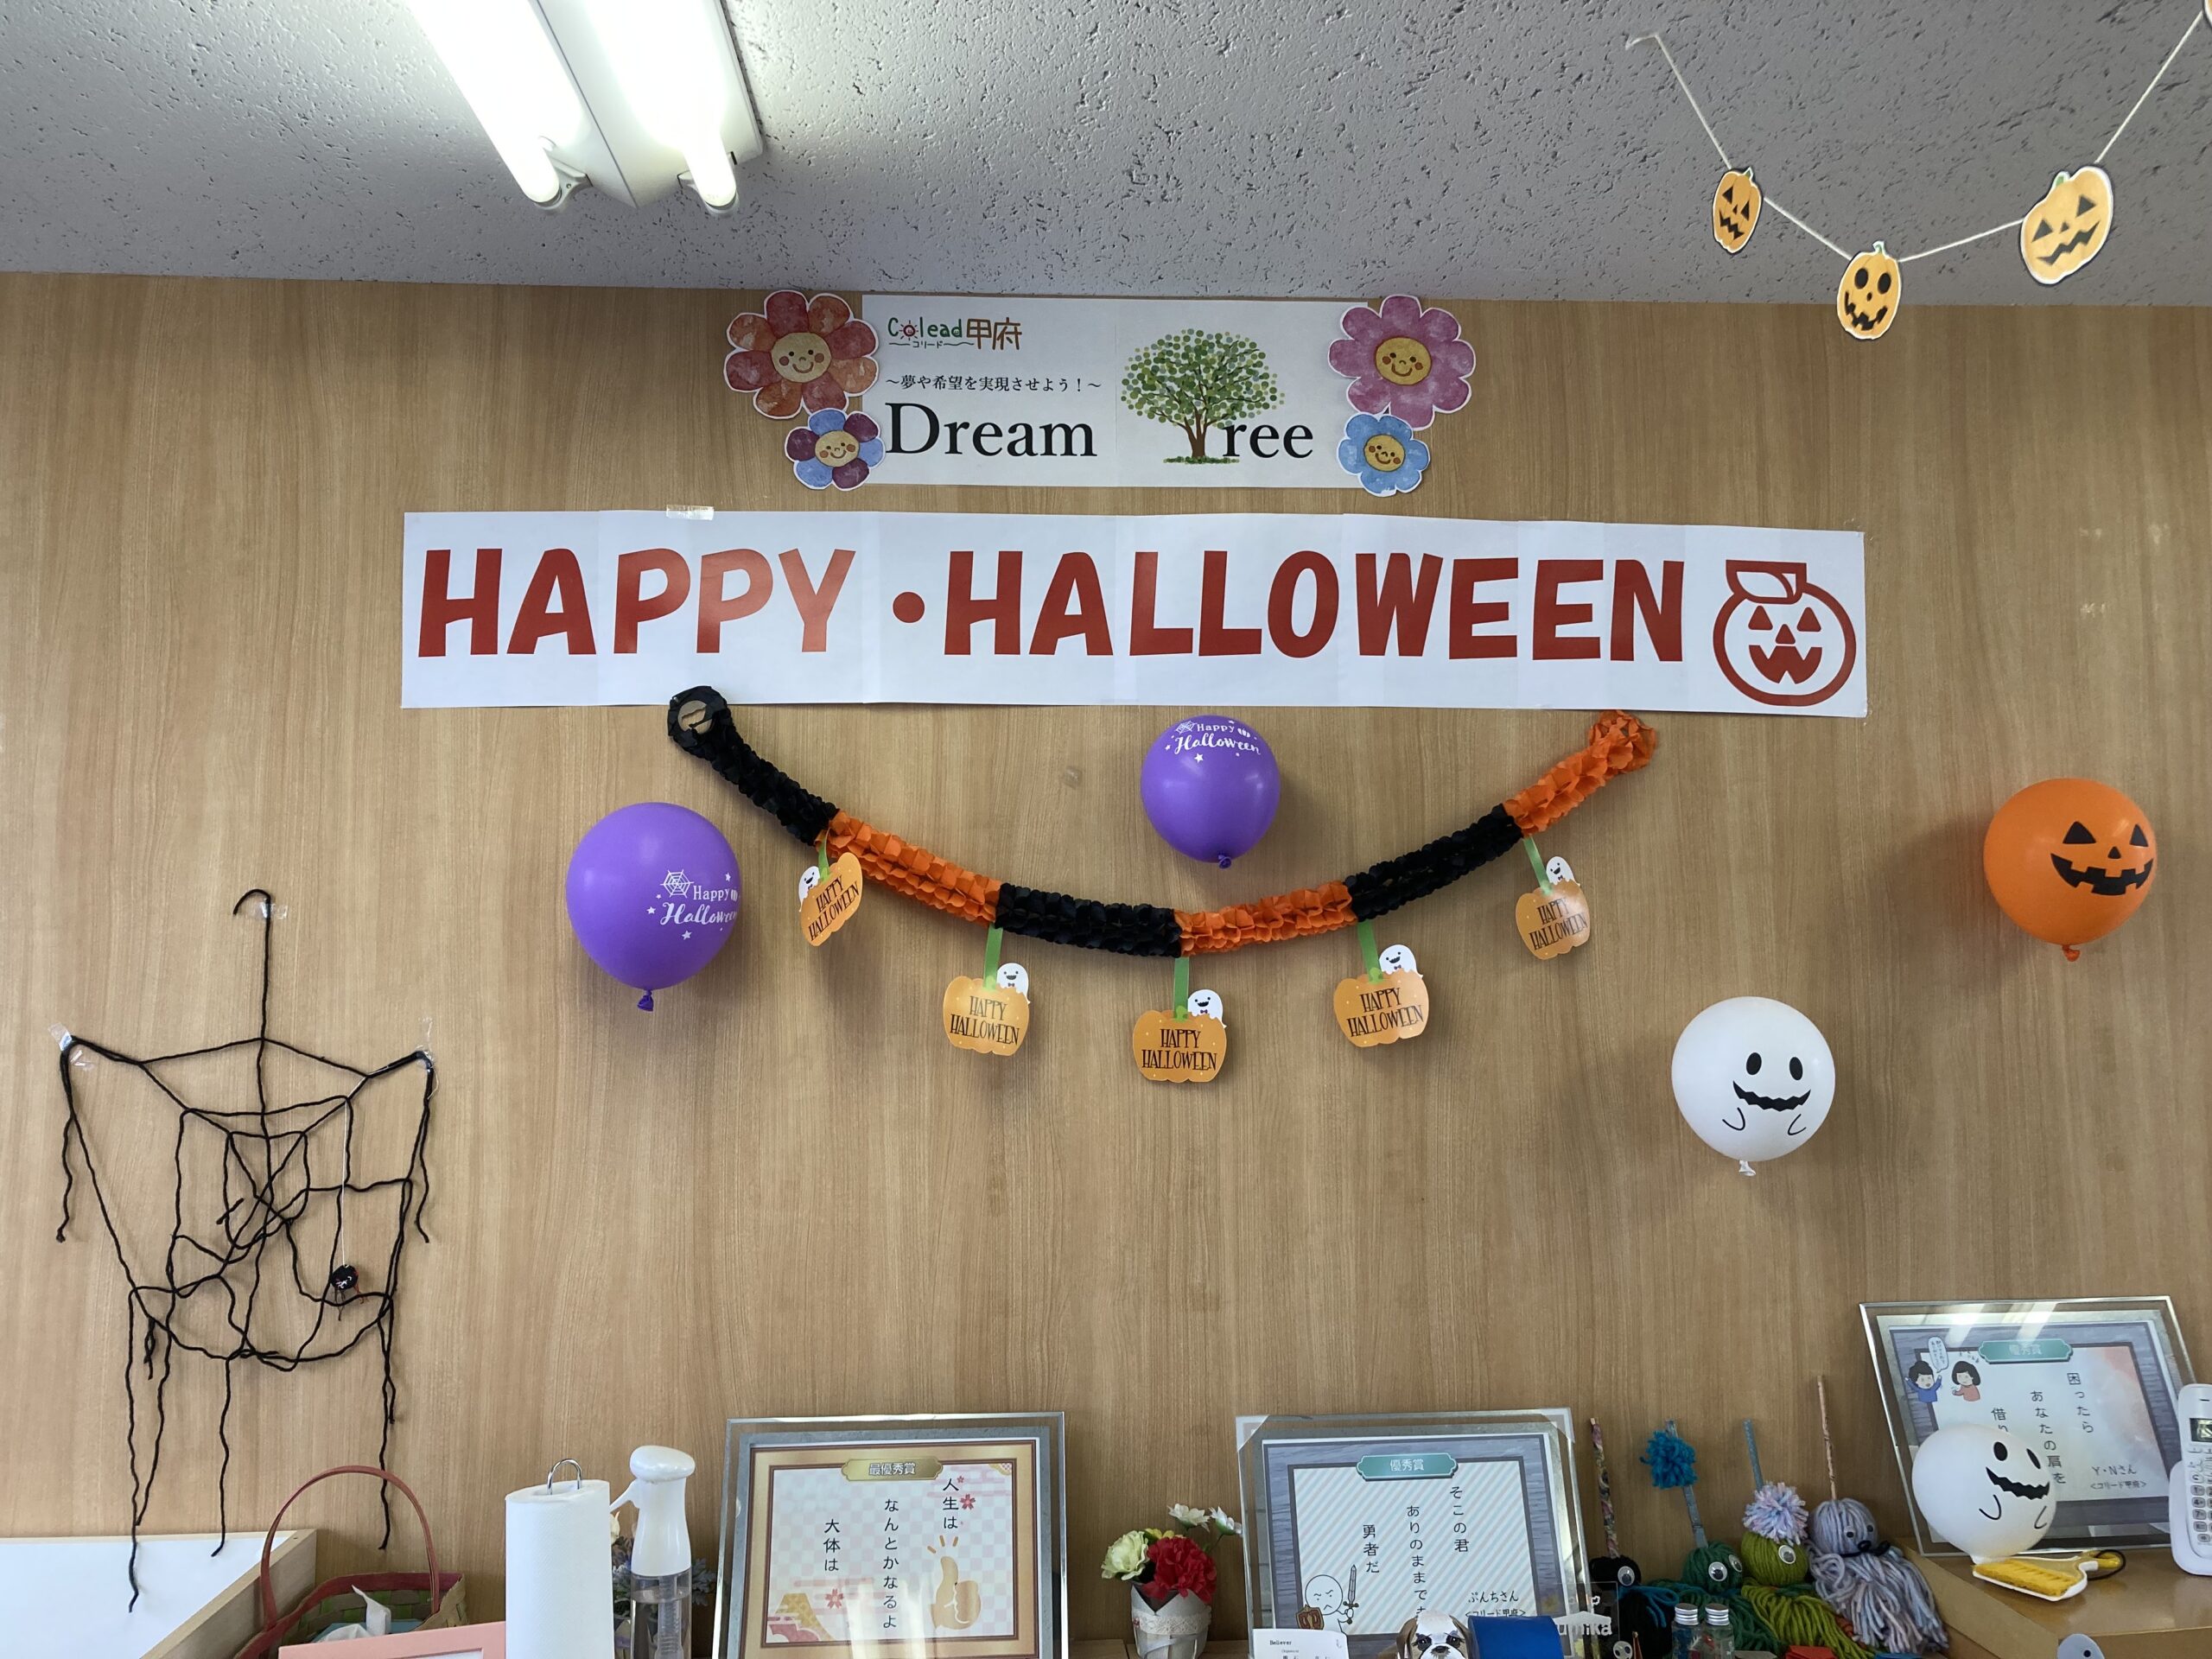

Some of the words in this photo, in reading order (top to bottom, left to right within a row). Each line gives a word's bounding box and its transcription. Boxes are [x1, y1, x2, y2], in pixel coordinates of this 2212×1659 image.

[885, 402, 1097, 457] Dream
[418, 548, 856, 658] HAPPY
[944, 550, 1684, 663] HALLOWEEN
[1174, 733, 1261, 755] Halloween
[1197, 722, 1235, 733] Happy
[693, 885, 729, 902] Happy
[808, 880, 860, 942] HALLOWEEN
[816, 874, 843, 913] HAPPY
[1536, 897, 1570, 925] HAPPY
[1529, 912, 1588, 950] HALLOWEEN
[969, 995, 1008, 1020] HAPPY
[1359, 987, 1401, 1013] HAPPY
[950, 1014, 1020, 1046] HALLOWEEN
[1160, 1028, 1201, 1049] HAPPY
[1346, 1004, 1424, 1037] HALLOWEEN
[1141, 1049, 1217, 1071] HALLOWEEN
[2066, 1372, 2094, 1433] 困ったら
[2030, 1390, 2066, 1484] あなたの肩を
[869, 1462, 916, 1476] 最優秀賞
[942, 1478, 959, 1529] 人生は
[1450, 1486, 1470, 1553] そこの君
[823, 1518, 841, 1572] 大体は
[883, 1498, 899, 1629] なんとかなるよ
[1362, 1523, 1380, 1574] 勇者だ
